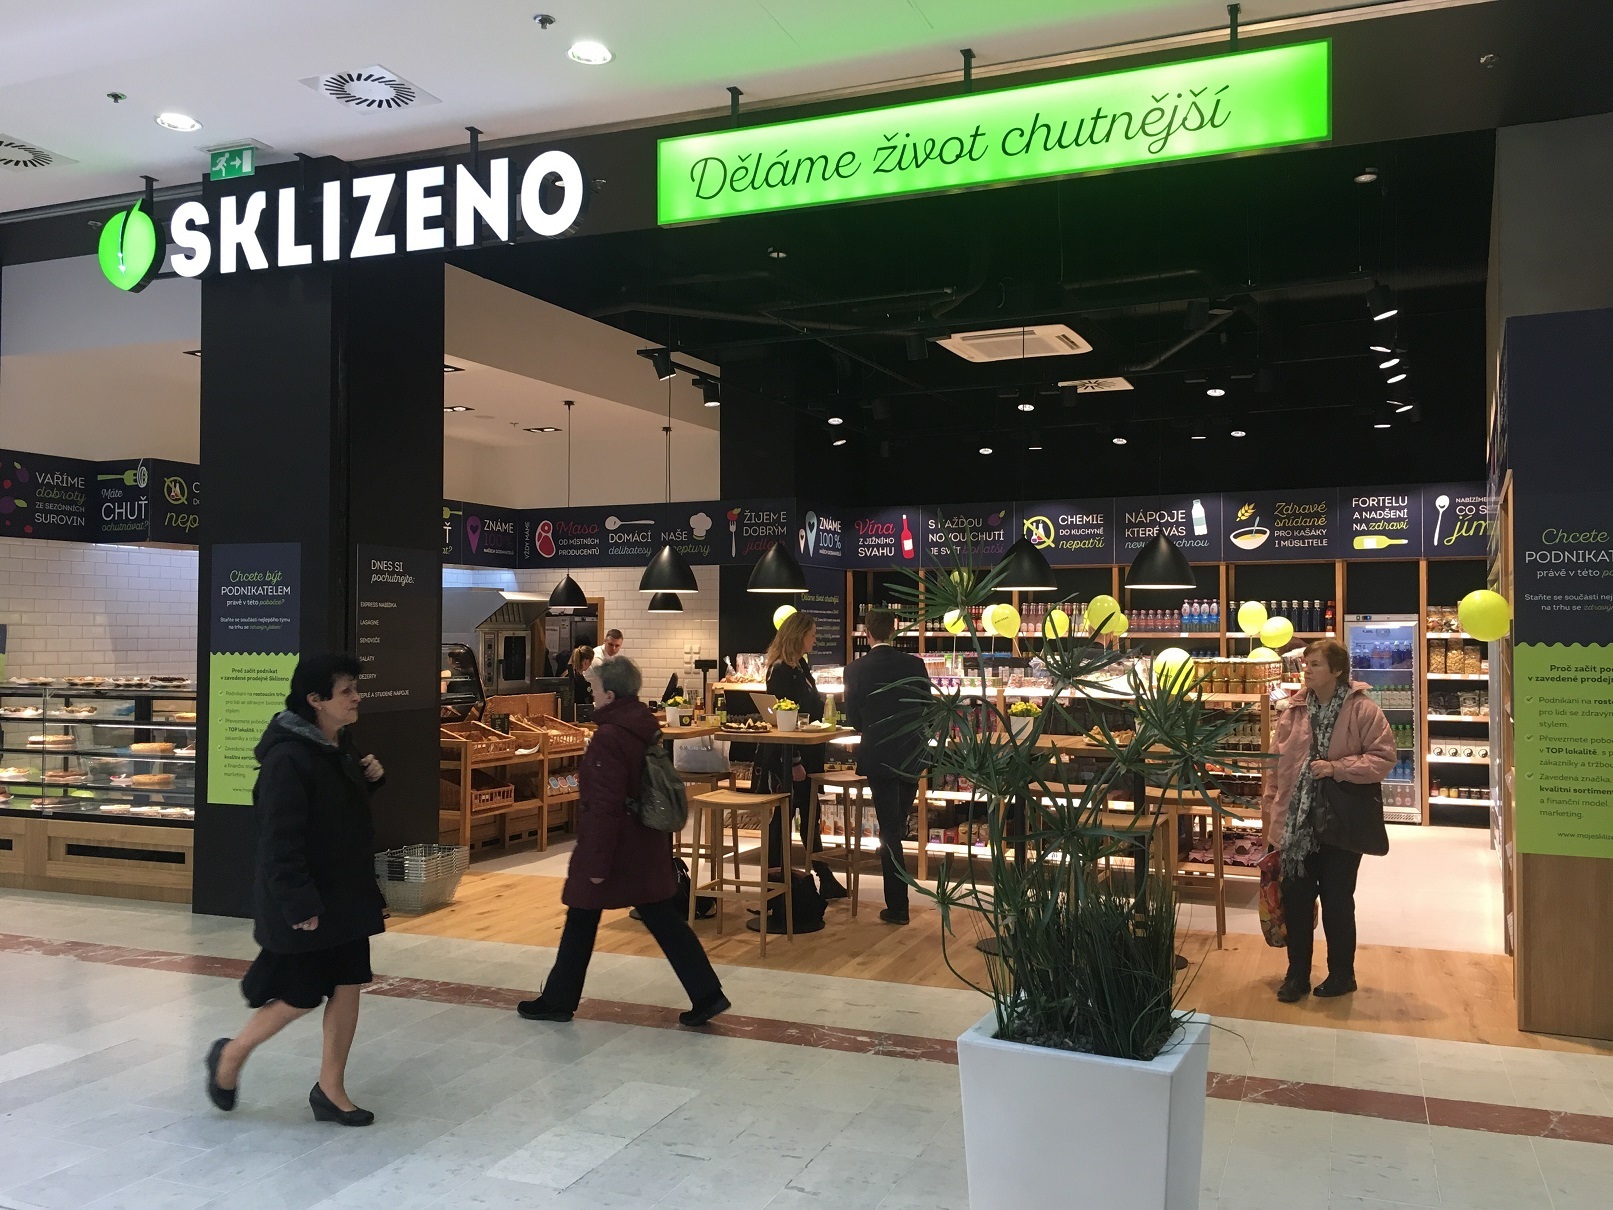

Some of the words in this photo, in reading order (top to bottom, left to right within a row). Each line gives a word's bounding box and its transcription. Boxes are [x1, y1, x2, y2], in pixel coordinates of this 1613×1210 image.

[690, 149, 861, 200] Děláme
[872, 124, 990, 174] život
[1000, 84, 1232, 155] chutnější
[170, 150, 584, 279] SKLIZENO
[35, 471, 86, 489] VAŘÍME
[35, 486, 87, 505] dobroty
[101, 488, 124, 499] Máte
[35, 502, 44, 510] ZE
[1352, 495, 1408, 508] FORTELU
[101, 495, 149, 522] CHUŤ
[1274, 501, 1328, 517] Zdravé
[1353, 512, 1361, 520] A
[1362, 507, 1409, 519] NADŠENÍ
[1456, 505, 1476, 515] CO
[34, 513, 86, 527] SUROVIN
[743, 509, 787, 524] ŽIJEME
[1058, 513, 1105, 526] CHEMIE
[1125, 508, 1186, 524] NÁPOJE
[1274, 515, 1328, 528] snídaně
[101, 521, 149, 533] ochutnávat?
[483, 518, 514, 534] ZNÁME
[556, 521, 600, 536] Maso
[743, 523, 787, 537] DOBRÝM
[819, 516, 842, 533] ZNÁME
[855, 518, 896, 535] Vína
[928, 519, 936, 529] S
[1162, 524, 1187, 537] VÁS
[1353, 522, 1368, 531] NA
[1368, 518, 1409, 531] zdraví
[608, 529, 652, 544] DOMÁCÍ
[661, 528, 688, 541] NAŠE
[928, 532, 968, 543] NOOU
[970, 528, 1005, 541] CHUTÍ
[1059, 528, 1070, 536] DO
[1071, 526, 1104, 536] KUCHYNĚ
[1274, 529, 1292, 538] PRO
[1293, 528, 1328, 537] KAŠÁKY
[1541, 528, 1611, 545] Chcete
[484, 533, 503, 548] 100
[558, 538, 569, 546] OD
[569, 537, 600, 546] MÍSTNÍCH
[819, 532, 834, 548] 100
[834, 534, 842, 549] %
[864, 534, 895, 545] JIŽNÍHO
[1058, 536, 1105, 552] nepatří
[1280, 537, 1329, 547] MÜSLITELE
[558, 547, 600, 557] PRODUCENTŮ
[608, 545, 652, 558] delikatesy
[661, 543, 711, 557] eptury
[742, 539, 786, 555] jídle
[858, 546, 895, 557] SVAHU
[371, 559, 393, 571] DNES
[394, 561, 404, 572] SI
[229, 569, 265, 583] Chcete
[265, 570, 283, 586] být
[1536, 568, 1566, 579] právě
[1577, 568, 1600, 577] této
[221, 585, 291, 596] PODNIKATELEM
[1524, 593, 1552, 601] Staňte
[1549, 664, 1572, 672] Proč
[1535, 674, 1579, 683] zavedené
[1538, 709, 1554, 717] pro
